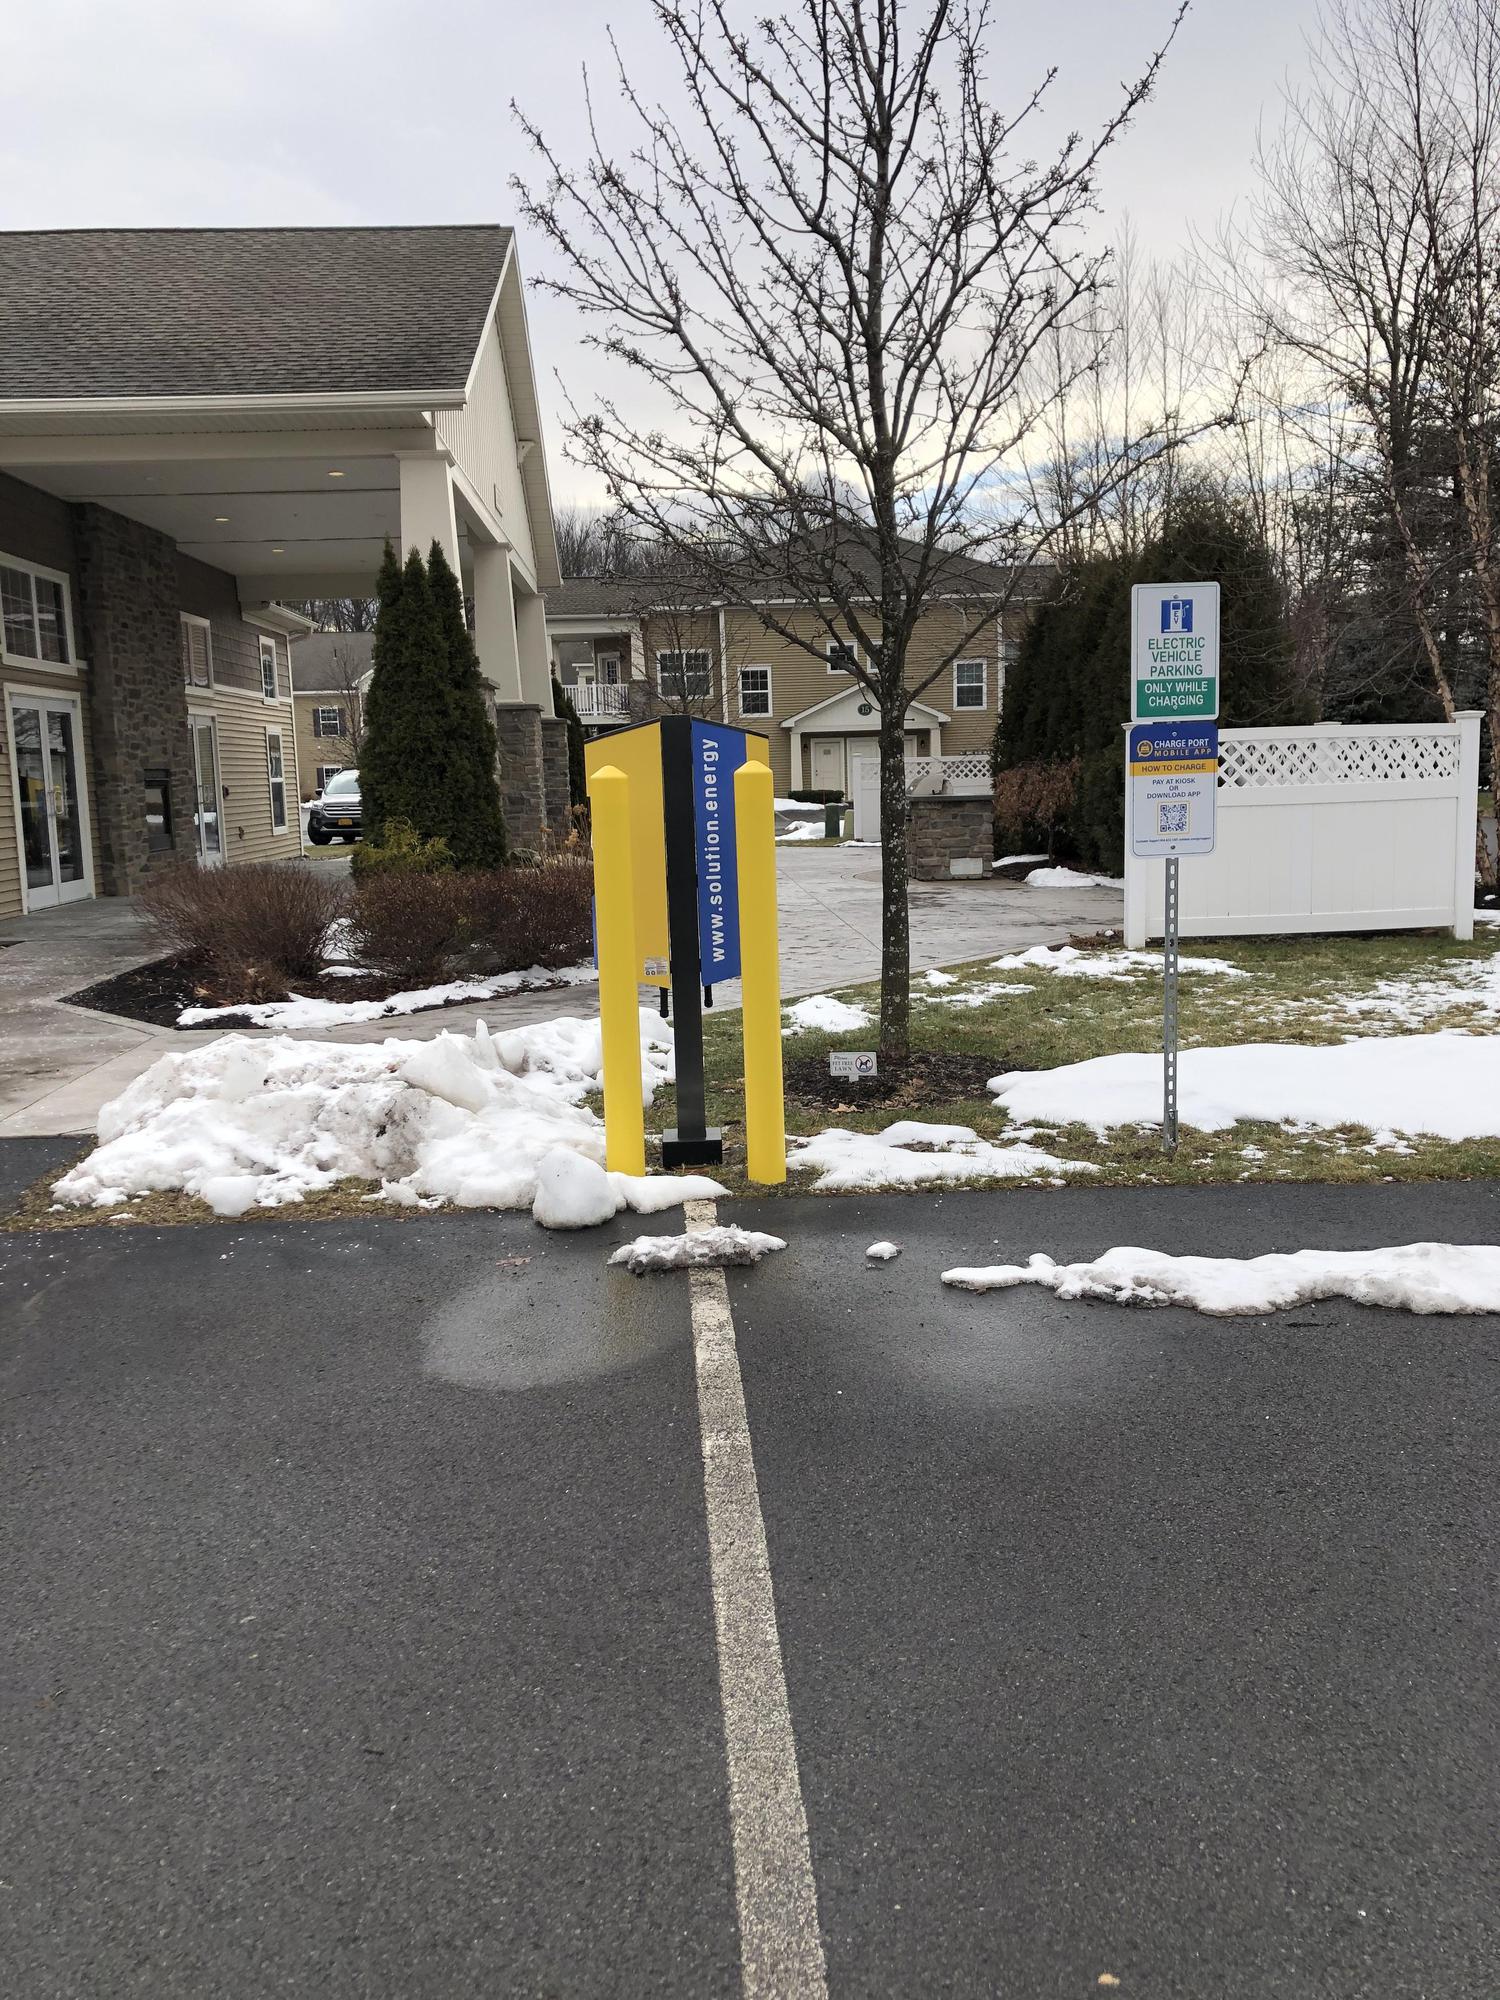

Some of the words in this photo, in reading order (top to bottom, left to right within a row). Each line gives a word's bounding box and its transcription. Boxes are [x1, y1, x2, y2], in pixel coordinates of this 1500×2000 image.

[1173, 610, 1179, 624] EV
[1148, 637, 1205, 650] ELECTRIC
[1152, 650, 1201, 662] VEHICLE
[1150, 664, 1203, 677] PARKING
[1144, 683, 1173, 694] ONLY
[1175, 681, 1208, 692] WHILE
[1148, 695, 1204, 707] CHARGING
[1154, 740, 1186, 749] CHARGE
[1188, 738, 1209, 747] PORT
[1154, 749, 1189, 757] MOBILE
[1141, 765, 1161, 773] HOW
[1174, 763, 1207, 771] CHARGE
[1146, 791, 1186, 799] DOWNLOAD
[702, 738, 726, 963] www.solution.energy
